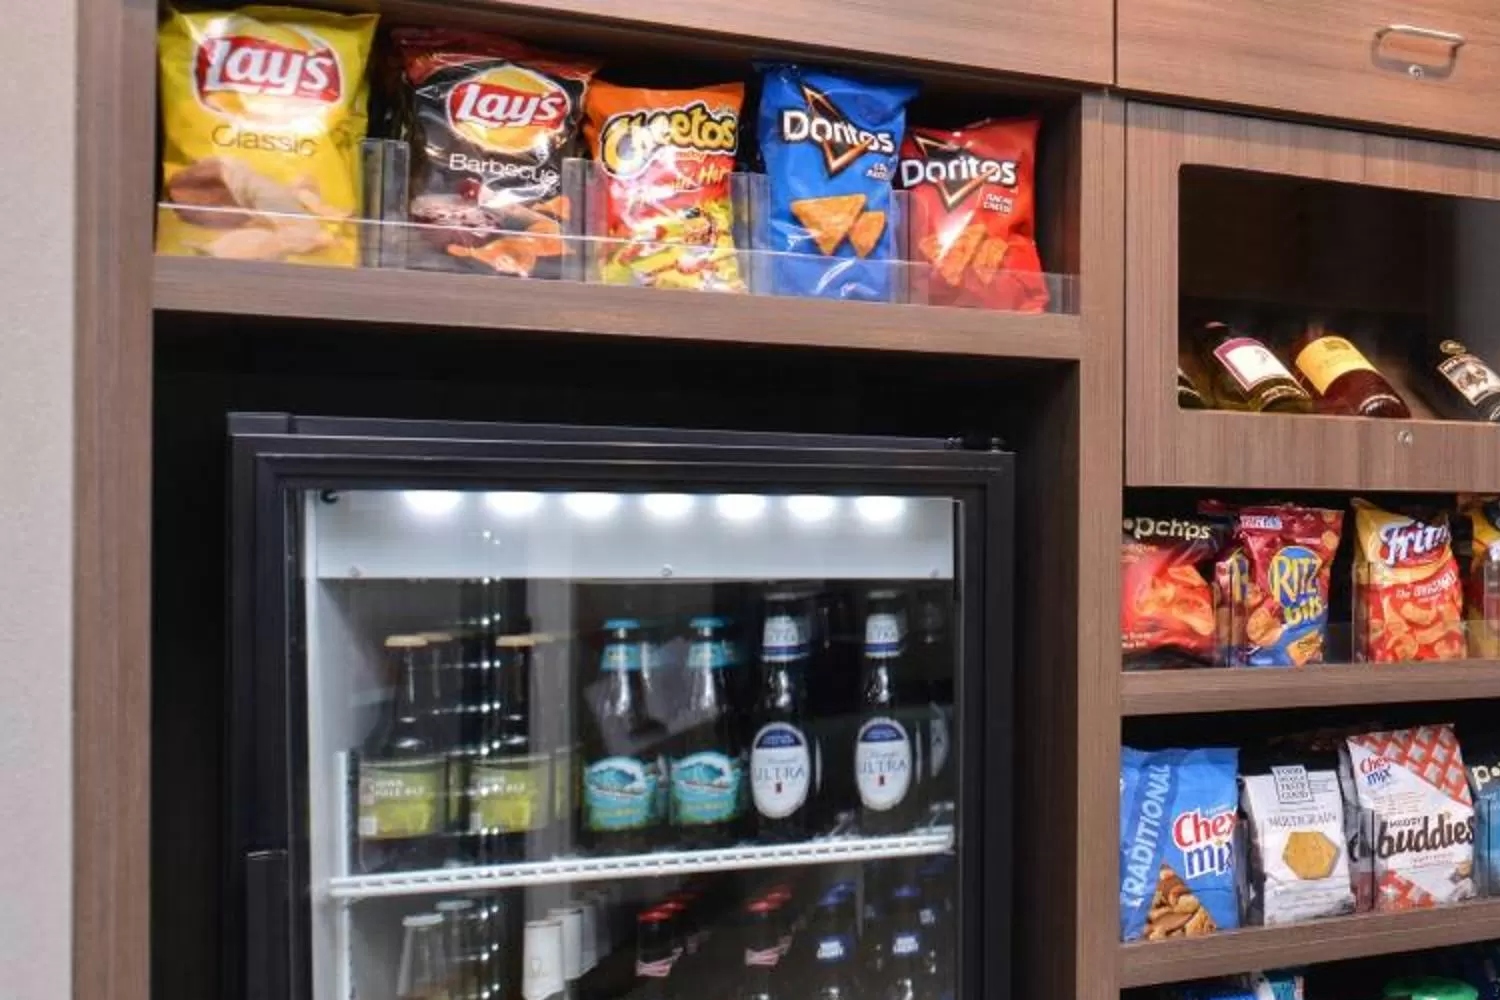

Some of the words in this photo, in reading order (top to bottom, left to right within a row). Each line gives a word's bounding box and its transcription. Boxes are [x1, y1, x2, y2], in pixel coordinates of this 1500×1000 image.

[204, 36, 333, 93] Lay's
[456, 84, 568, 128] Lay's
[211, 124, 318, 157] Classic
[602, 101, 737, 170] Cheetos
[783, 109, 897, 153] Doritos
[449, 152, 561, 187] Barbecue
[901, 156, 1017, 188] Doritos
[1271, 553, 1323, 604] RITZ
[1122, 763, 1172, 908] TRADITIONAL
[1172, 804, 1240, 850] Chex
[1377, 811, 1475, 859] buddies
